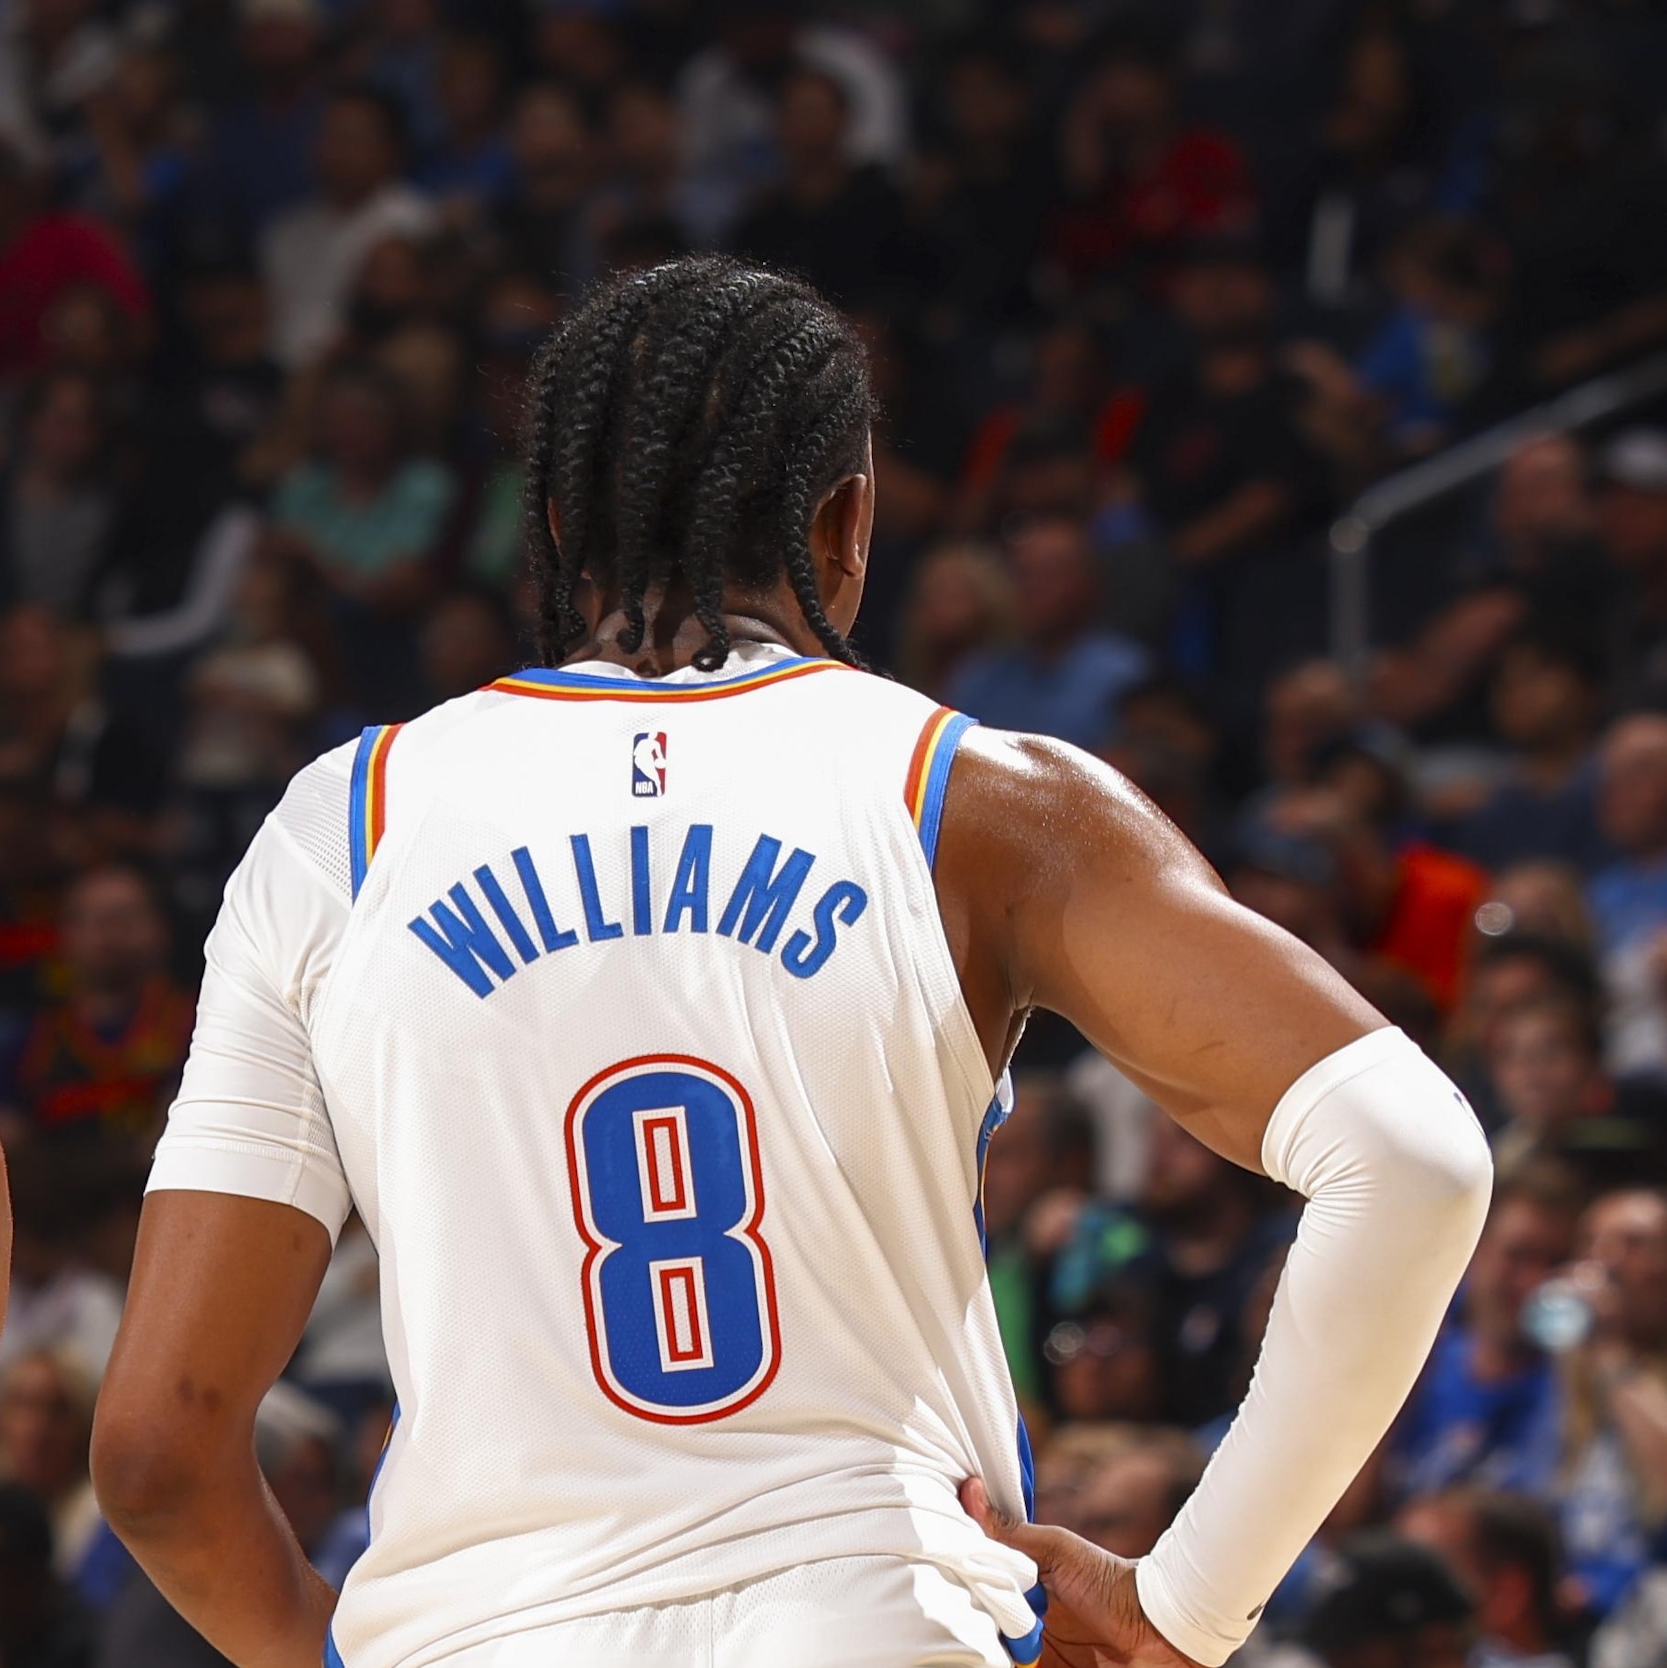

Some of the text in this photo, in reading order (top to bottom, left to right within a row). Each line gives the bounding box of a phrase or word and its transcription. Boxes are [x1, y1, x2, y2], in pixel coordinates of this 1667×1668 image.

[635, 781, 655, 795] NBA
[410, 824, 868, 999] WILLIAMS
[563, 1053, 782, 1426] 8
